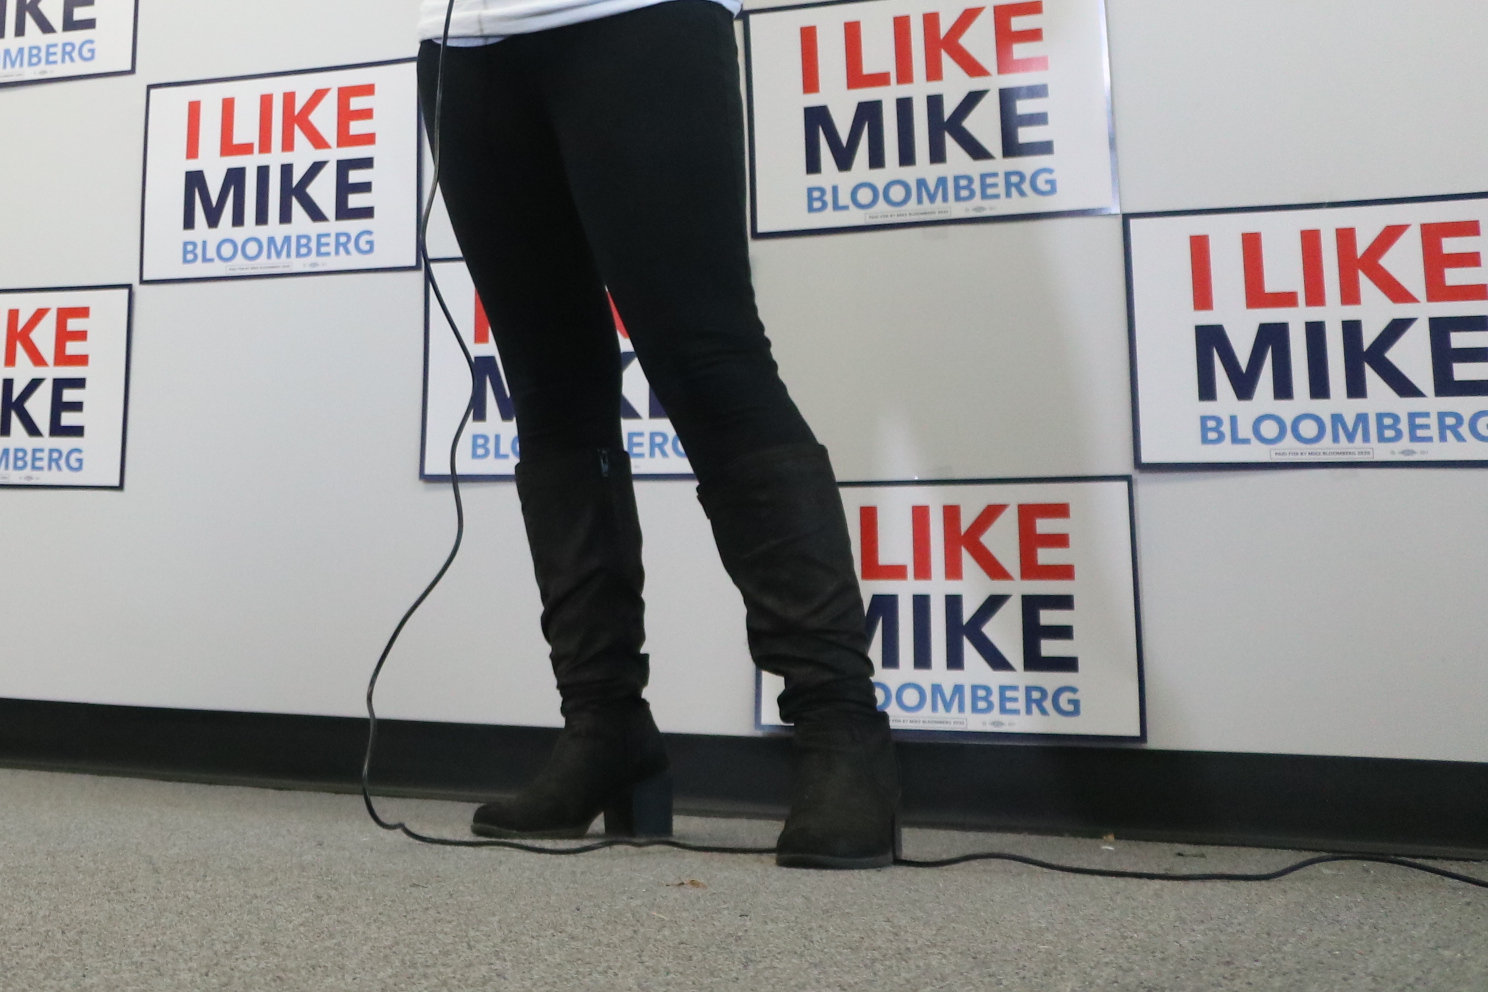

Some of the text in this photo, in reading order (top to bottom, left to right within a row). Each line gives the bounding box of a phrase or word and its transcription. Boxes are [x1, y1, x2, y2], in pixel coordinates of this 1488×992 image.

[799, 0, 1050, 95] I LIKE
[185, 83, 377, 160] I LIKE
[803, 84, 1054, 176] MIKE
[182, 156, 375, 231] MIKE
[806, 165, 1058, 214] BLOOMBERG
[181, 229, 376, 264] BLOOMBERG
[1189, 219, 1488, 312] I LIKE
[1194, 314, 1488, 402] MIKE
[859, 502, 1076, 582] LIKE
